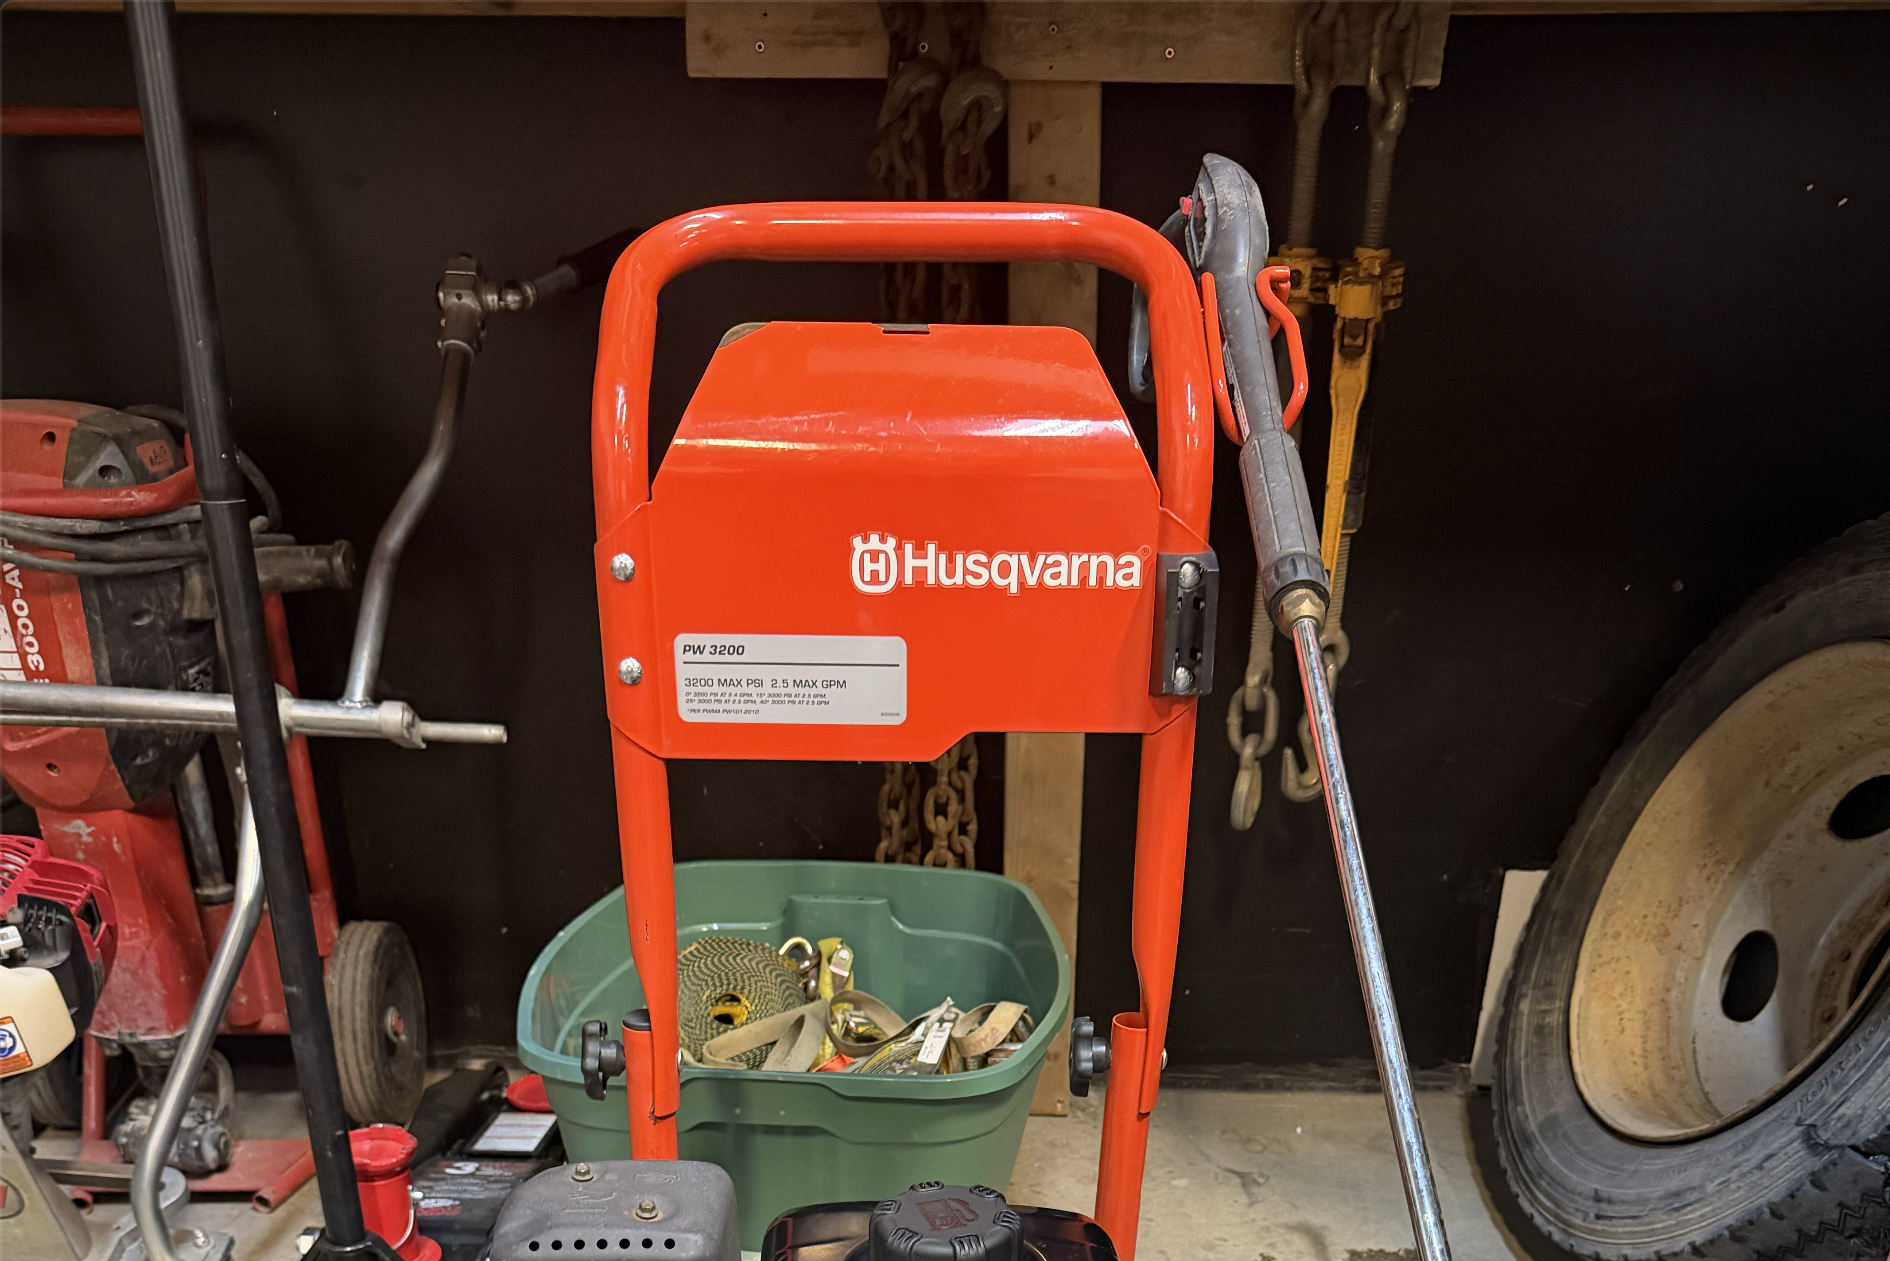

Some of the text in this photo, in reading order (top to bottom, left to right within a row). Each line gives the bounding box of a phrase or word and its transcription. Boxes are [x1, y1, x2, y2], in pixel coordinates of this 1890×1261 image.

[904, 544, 1142, 594] Husqvarna
[682, 644, 745, 656] PW 3200
[684, 678, 846, 689] 3200 MAX PSI 2.5 MAX GPM
